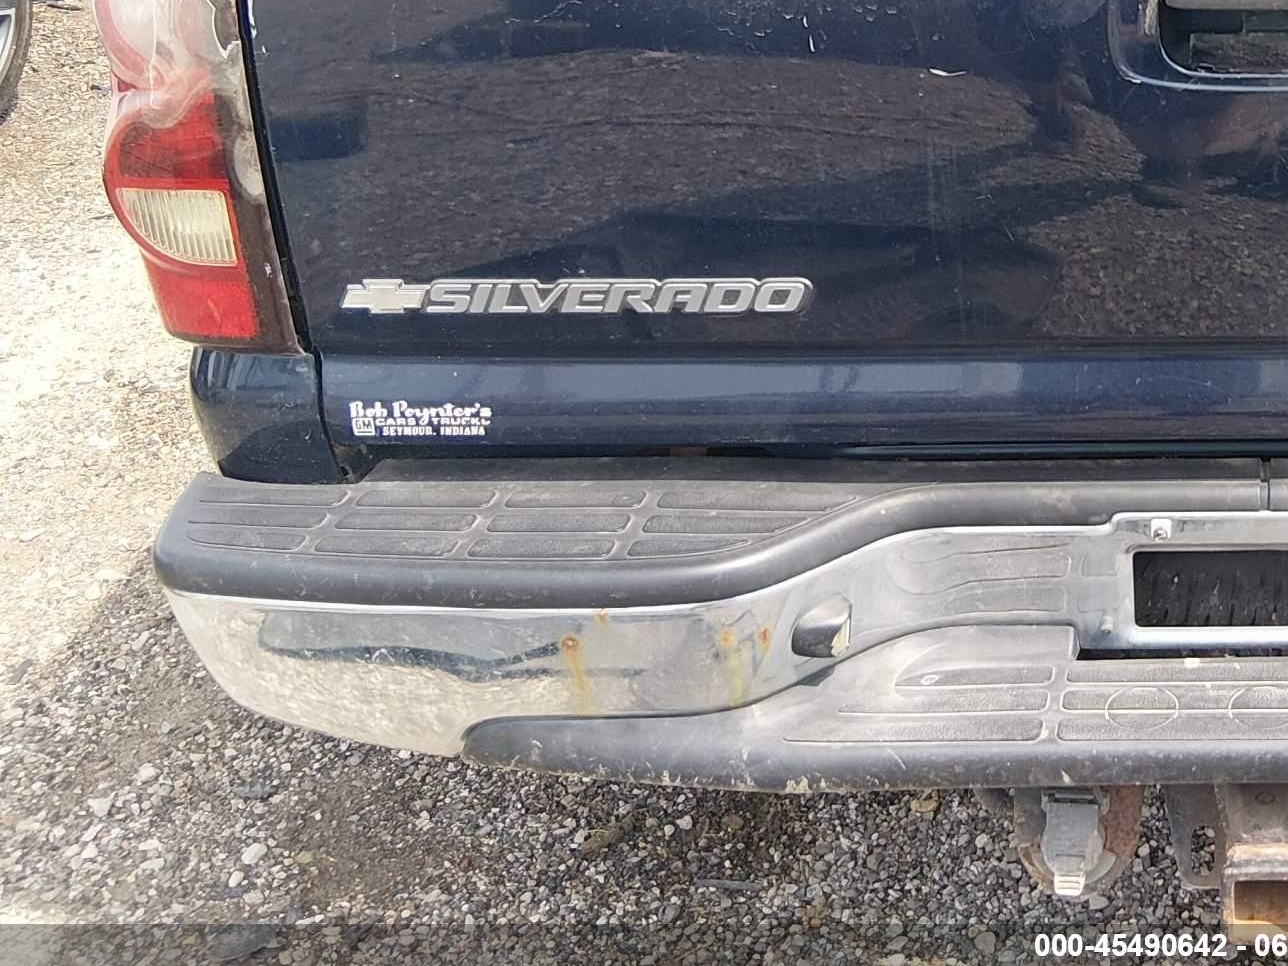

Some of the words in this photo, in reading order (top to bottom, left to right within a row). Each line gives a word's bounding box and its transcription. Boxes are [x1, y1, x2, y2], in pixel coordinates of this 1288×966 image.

[425, 279, 813, 314] SILVERADO
[349, 400, 388, 418] Bob
[392, 400, 492, 425] Poynter's
[375, 417, 416, 426] CARS
[439, 425, 486, 436] INDIANA
